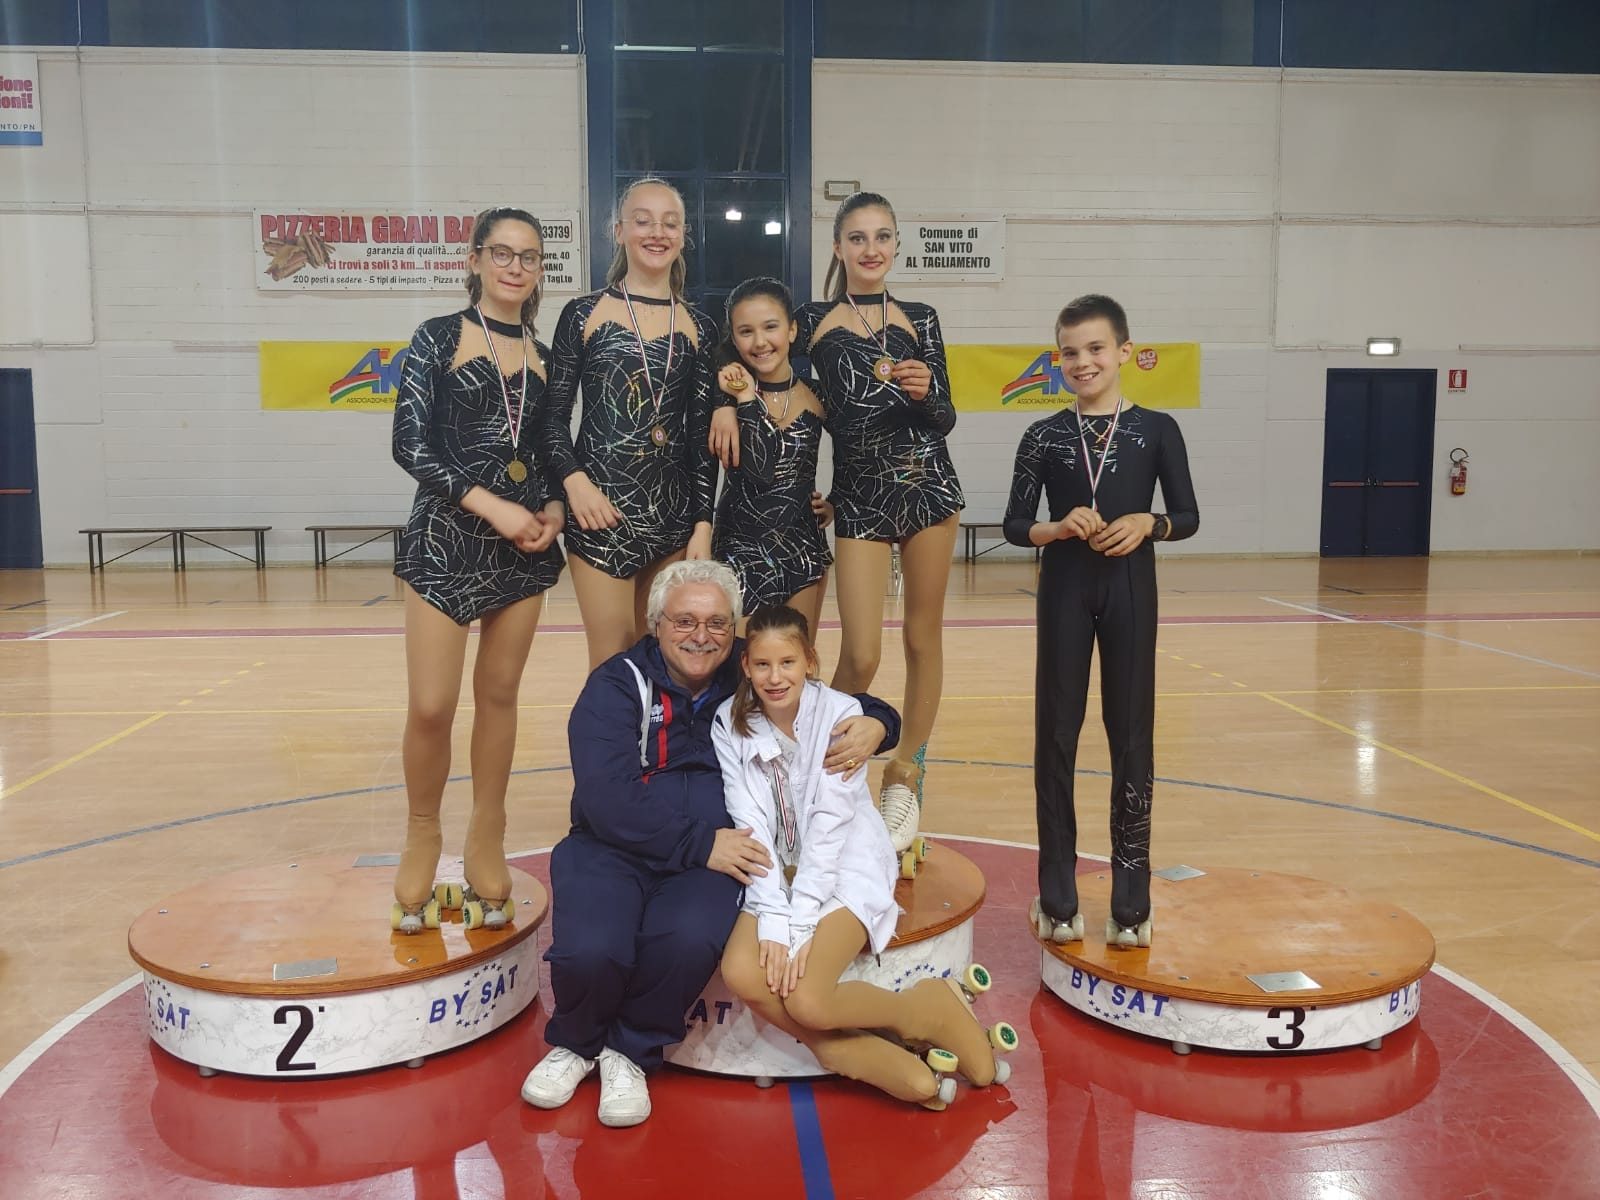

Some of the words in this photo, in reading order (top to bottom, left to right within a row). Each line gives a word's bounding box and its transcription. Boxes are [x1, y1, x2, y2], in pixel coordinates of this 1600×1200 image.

[260, 214, 368, 244] PIZZERIA
[371, 215, 439, 244] GRAN
[443, 215, 475, 244] BA
[542, 225, 570, 239] 33739
[919, 226, 963, 239] Comune
[967, 226, 979, 239] di
[366, 245, 405, 257] garanzia
[406, 245, 415, 255] di
[924, 241, 945, 254] SAN
[949, 241, 973, 254] VITO
[544, 252, 559, 260] ore,
[560, 251, 570, 260] 40
[338, 259, 361, 270] trovi
[363, 261, 370, 270] a
[371, 259, 390, 270] soli
[391, 259, 399, 270] 3
[433, 260, 465, 271] aspett
[905, 256, 918, 269] AL
[921, 256, 991, 269] TAGLIAMENTO
[292, 275, 310, 284] 200
[310, 275, 329, 286] posti
[336, 275, 362, 284] sedere
[369, 275, 375, 284] 5
[376, 275, 389, 286] tipi
[390, 275, 397, 284] di
[398, 275, 427, 286] impasto
[433, 275, 454, 284] Pizza
[429, 989, 470, 1024] BY
[480, 964, 519, 1005] SAT
[1071, 967, 1102, 996] BY
[1111, 984, 1170, 1017] SAT
[157, 997, 190, 1030] SAT
[689, 998, 733, 1025] AT
